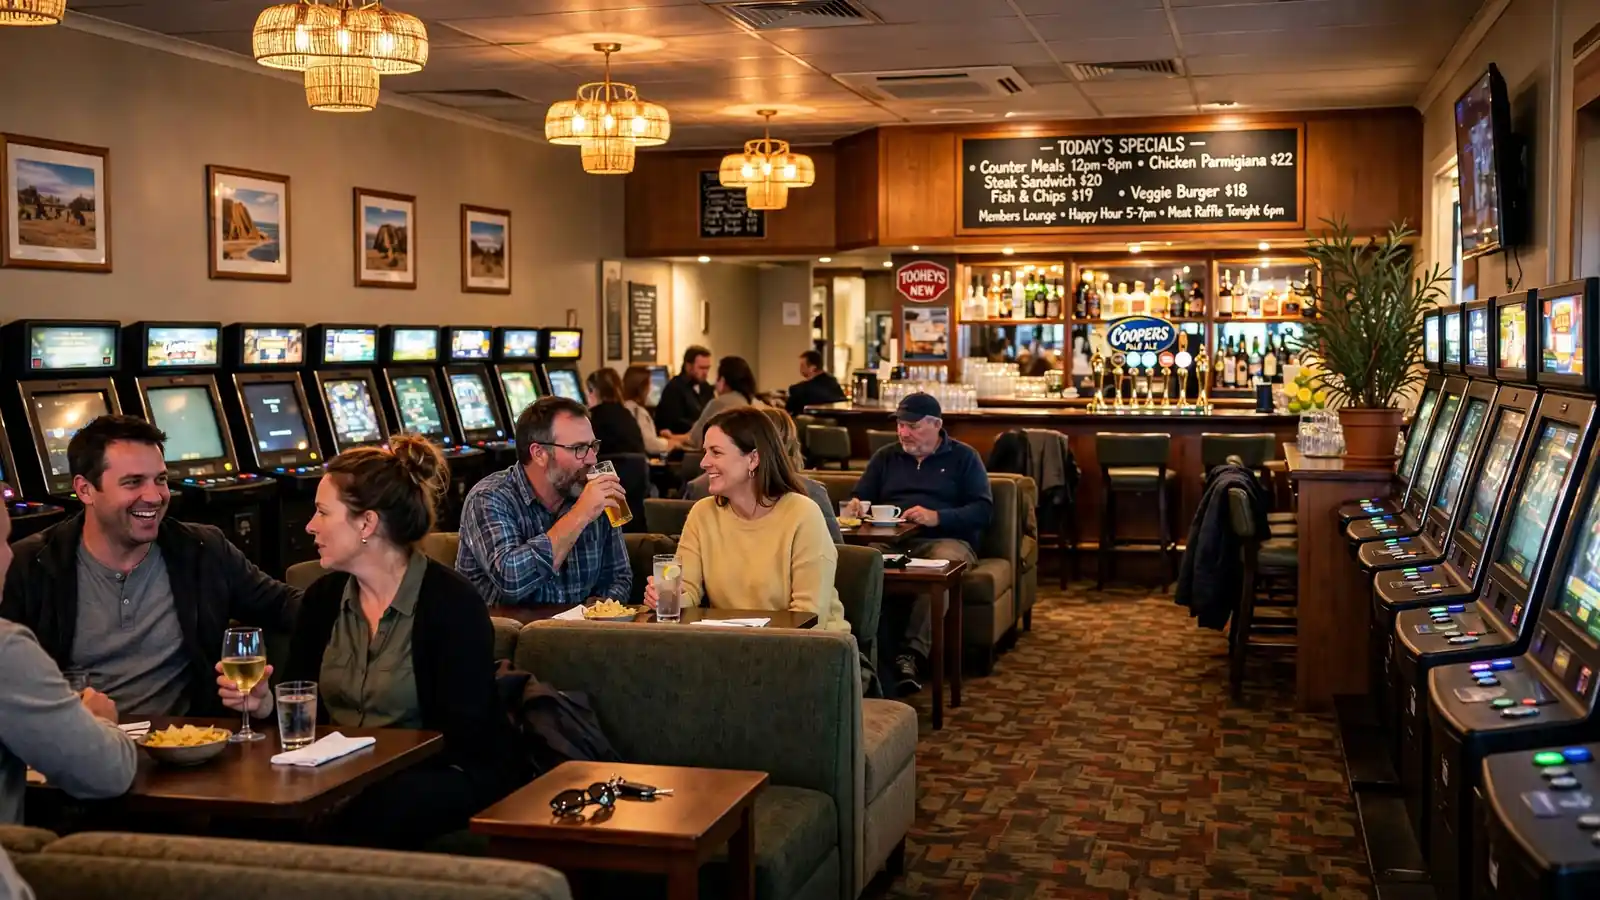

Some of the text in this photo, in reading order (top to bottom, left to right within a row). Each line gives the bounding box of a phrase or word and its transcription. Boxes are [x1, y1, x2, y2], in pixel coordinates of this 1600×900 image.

[1058, 136, 1185, 156] TODAY'S SPECIALS
[980, 152, 1293, 174] Counter Meals 12pm-8pm Chicken Parmigiana $22
[984, 174, 1102, 189] Steak Sandwich $20
[990, 183, 1248, 206] Fish & Chips $19 Veggie Burger $18
[978, 204, 1284, 224] Members Lounge Happy Hour 5-7pm Meat Raffle Tonight 6pm
[900, 270, 946, 284] TOOHEYS
[910, 285, 936, 296] NEW
[1111, 324, 1169, 346] COOPERS
